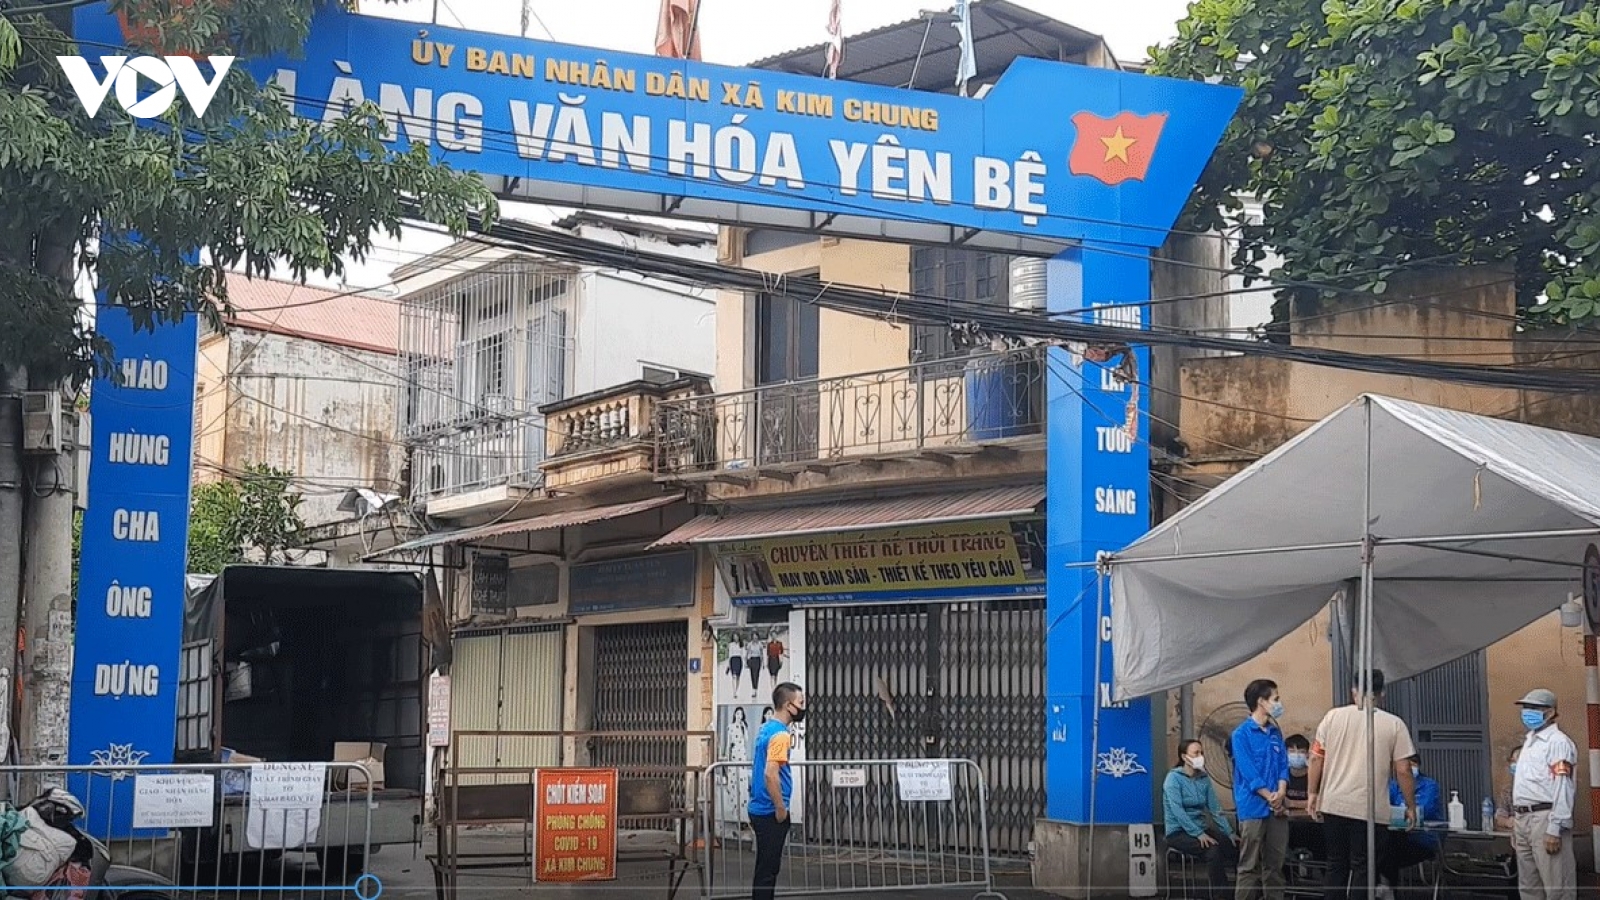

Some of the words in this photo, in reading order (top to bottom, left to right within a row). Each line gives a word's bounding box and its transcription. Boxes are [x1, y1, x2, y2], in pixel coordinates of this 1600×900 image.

[411, 29, 455, 67] ỦY
[466, 47, 535, 79] BAN
[544, 59, 635, 92] NHÂN
[644, 71, 710, 102] DÂN
[721, 81, 764, 109] XÃ
[776, 88, 833, 117] KIM
[843, 98, 939, 131] CHUNG
[276, 59, 483, 154] LÀNG
[509, 92, 650, 173] VĂN
[668, 113, 805, 189] HÓA
[828, 133, 952, 205] YÊN
[974, 150, 1047, 226] BỆ
[121, 353, 168, 390] HÀO
[109, 427, 170, 466] HÙNG
[1095, 484, 1137, 515] SÁNG
[113, 508, 160, 542] CHA
[770, 540, 829, 565] CHUYÊN
[949, 530, 1006, 552] TRANG
[778, 572, 803, 588] MAY
[878, 560, 911, 583] THIẾT
[911, 559, 930, 581] KẾ
[929, 561, 962, 580] THEO
[962, 557, 987, 578] YÊU
[105, 579, 152, 618] ÔNG
[94, 659, 160, 701] DỰNG
[546, 778, 566, 805] CHỐT
[566, 776, 587, 805] KIỂM
[546, 811, 576, 830] PHÒNG
[577, 810, 606, 830] CHỐNG
[554, 836, 579, 851] COVID
[587, 835, 598, 851] 19
[1134, 833, 1150, 849] H3
[558, 857, 576, 872] KIM
[577, 856, 606, 871] CHUNG
